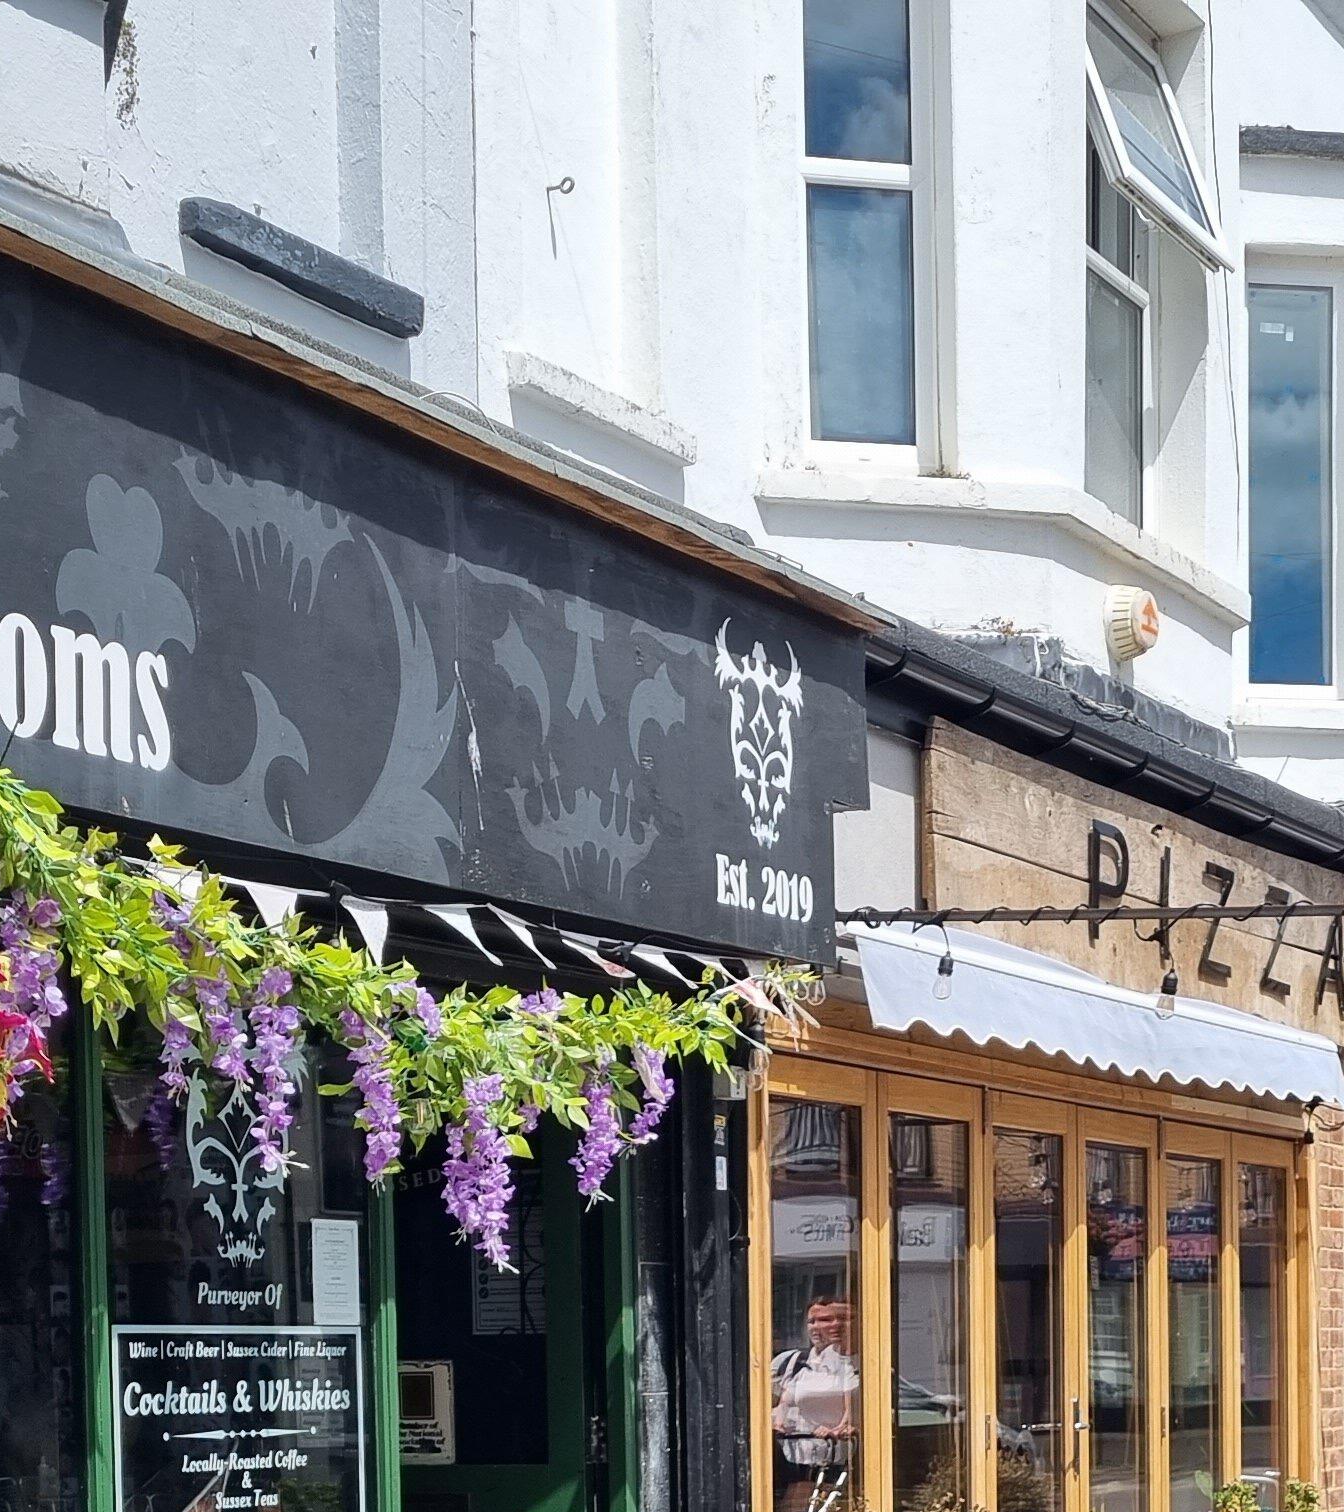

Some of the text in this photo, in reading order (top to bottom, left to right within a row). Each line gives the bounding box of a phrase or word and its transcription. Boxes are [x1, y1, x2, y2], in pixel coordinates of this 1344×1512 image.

[716, 853, 813, 922] Est. 2019
[197, 1281, 283, 1311] Purveyor Of
[129, 1340, 347, 1360] Wine Craft Beer Sussex Cider Fine Liquor
[123, 1379, 227, 1416] Cocktails
[233, 1380, 253, 1413] &
[258, 1377, 351, 1412] Whiskies
[181, 1449, 308, 1474] Locally-Roasted Coffee
[241, 1471, 253, 1489] &
[215, 1489, 279, 1510] Sussex Teas
